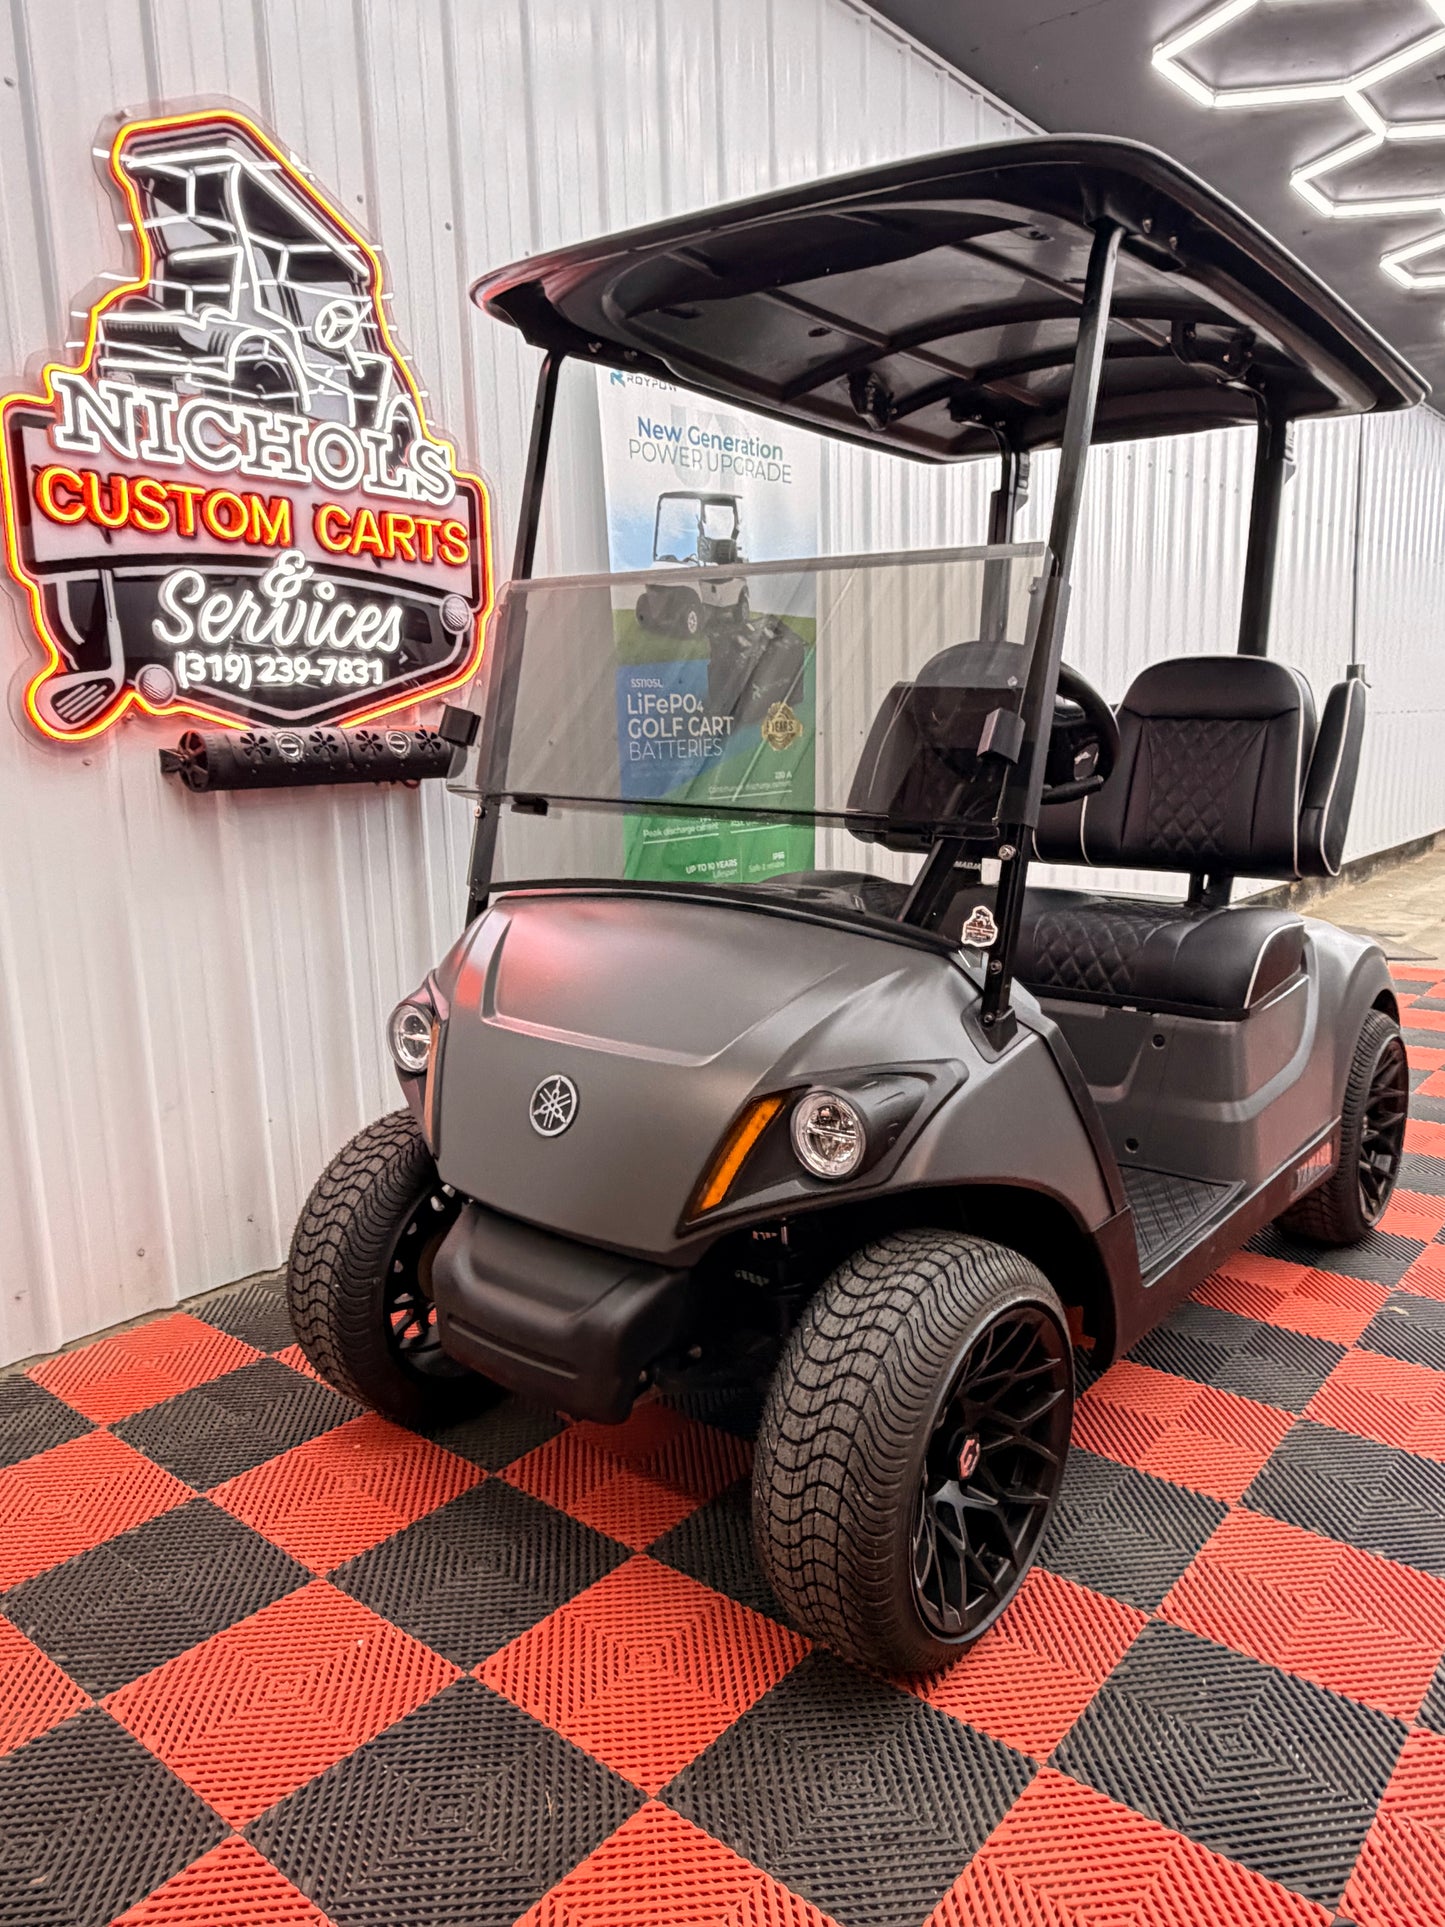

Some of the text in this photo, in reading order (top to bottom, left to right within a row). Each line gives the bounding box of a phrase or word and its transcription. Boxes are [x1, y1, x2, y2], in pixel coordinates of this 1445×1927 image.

[50, 371, 456, 506] NICHOLS
[637, 416, 783, 461] New Generation
[629, 439, 792, 484] POWER UPGRADE
[36, 465, 470, 568] CUSTOM CARTS
[261, 550, 314, 607] &
[152, 569, 402, 652] Services
[175, 651, 384, 690] (319) 239-7831
[628, 716, 734, 739] GOLF CART
[629, 738, 723, 761] BATTERIES
[686, 865, 697, 874] UP
[697, 863, 707, 872] TO
[716, 859, 738, 869] YEARS
